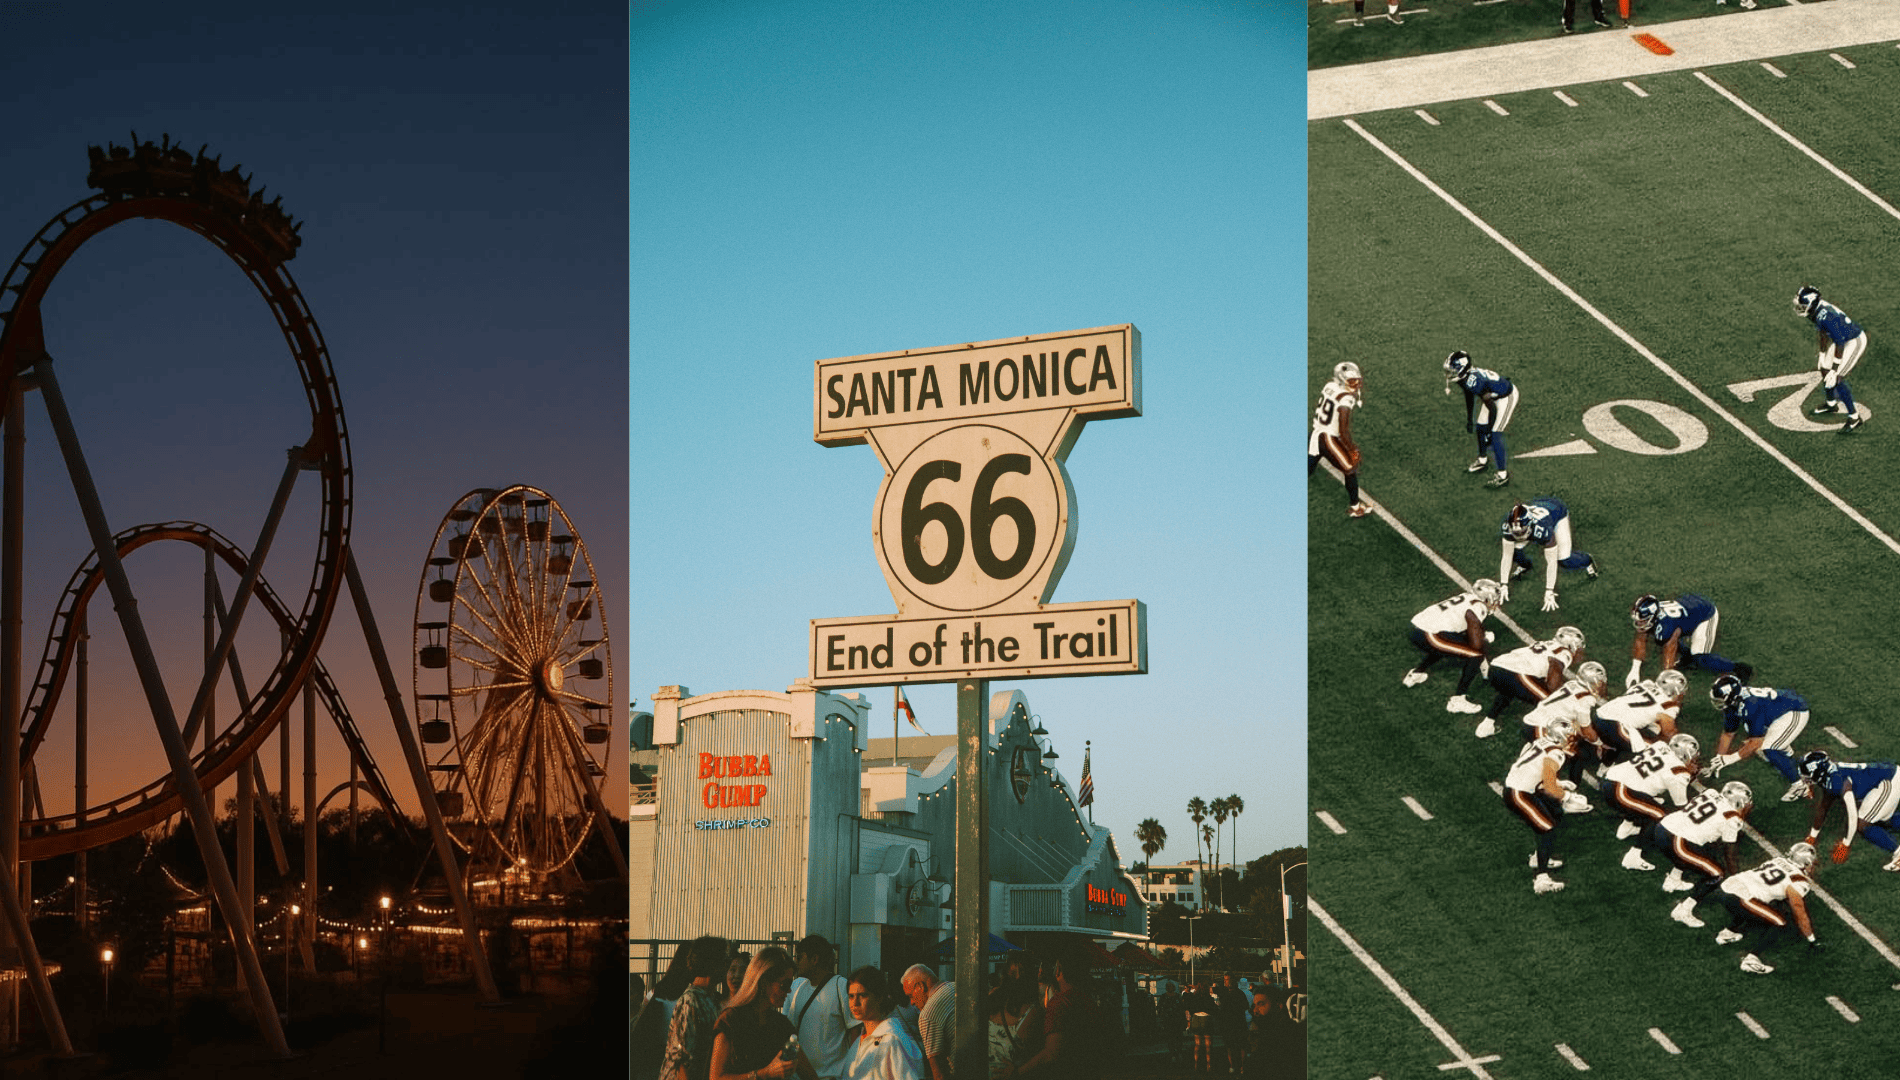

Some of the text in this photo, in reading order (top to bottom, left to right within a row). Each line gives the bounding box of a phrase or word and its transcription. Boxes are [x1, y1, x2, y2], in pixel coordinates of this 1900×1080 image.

[827, 344, 1118, 419] SANTA MONICA
[901, 453, 1037, 585] 66
[827, 614, 1118, 672] End of the Trail
[698, 752, 773, 779] BUBBA
[702, 782, 767, 809] GUMP
[695, 820, 745, 830] SHRIMP
